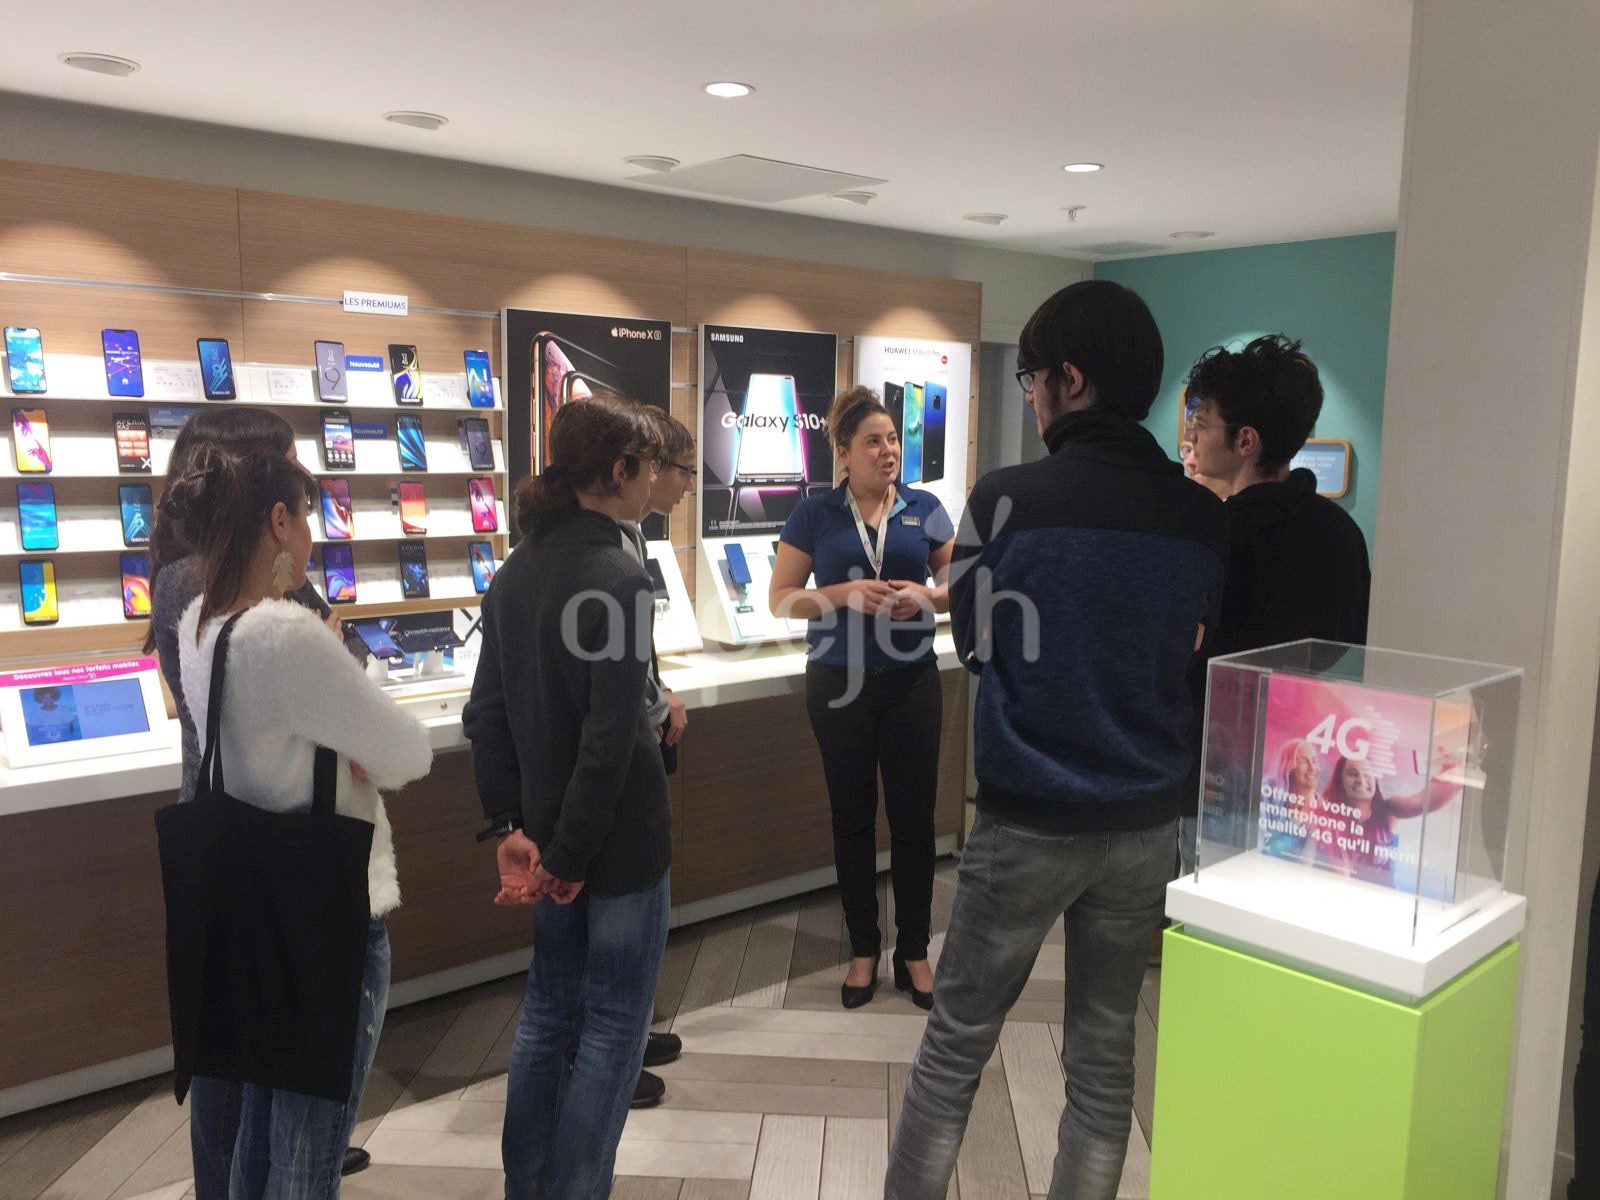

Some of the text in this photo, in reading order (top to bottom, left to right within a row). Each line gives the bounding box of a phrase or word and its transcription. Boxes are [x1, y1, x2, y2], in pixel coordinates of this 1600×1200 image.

[344, 297, 407, 310] LES PREMIUMS
[619, 327, 646, 339] iPhone
[711, 333, 744, 343] SAMSUNG
[884, 346, 910, 355] HUAWEI
[721, 411, 789, 432] Galaxy
[13, 670, 52, 681] Découvrez
[54, 669, 70, 677] tous
[85, 664, 111, 673] forfaits
[112, 660, 140, 669] mobiles
[1305, 714, 1372, 761] 4G
[1261, 785, 1305, 807] Offrez
[1322, 799, 1362, 820] votre
[1259, 801, 1364, 837] smartphone la
[1258, 817, 1307, 839] qualité
[1311, 829, 1333, 845] 4G
[1336, 838, 1370, 855] qu'il
